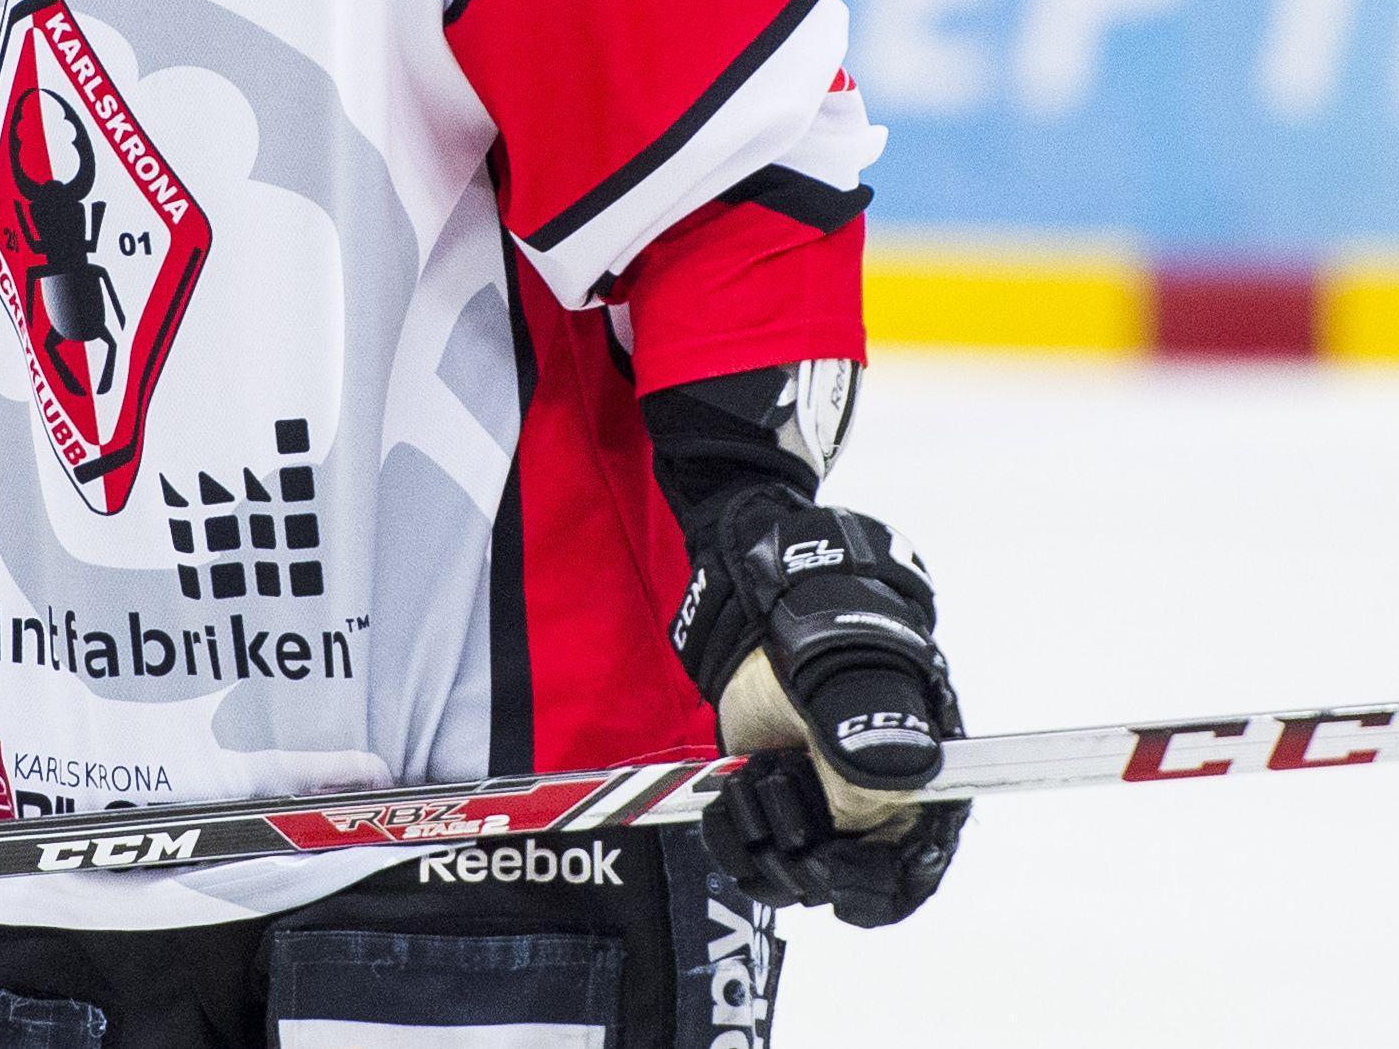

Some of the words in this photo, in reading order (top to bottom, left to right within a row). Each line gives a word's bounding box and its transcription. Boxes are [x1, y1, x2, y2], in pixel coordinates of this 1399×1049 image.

[45, 12, 189, 225] KARLSKRONA
[118, 232, 152, 257] 01
[673, 567, 707, 651] CCM
[15, 753, 173, 792] KARLSKRONA
[36, 828, 202, 871] CCM
[419, 838, 624, 886] Reebok
